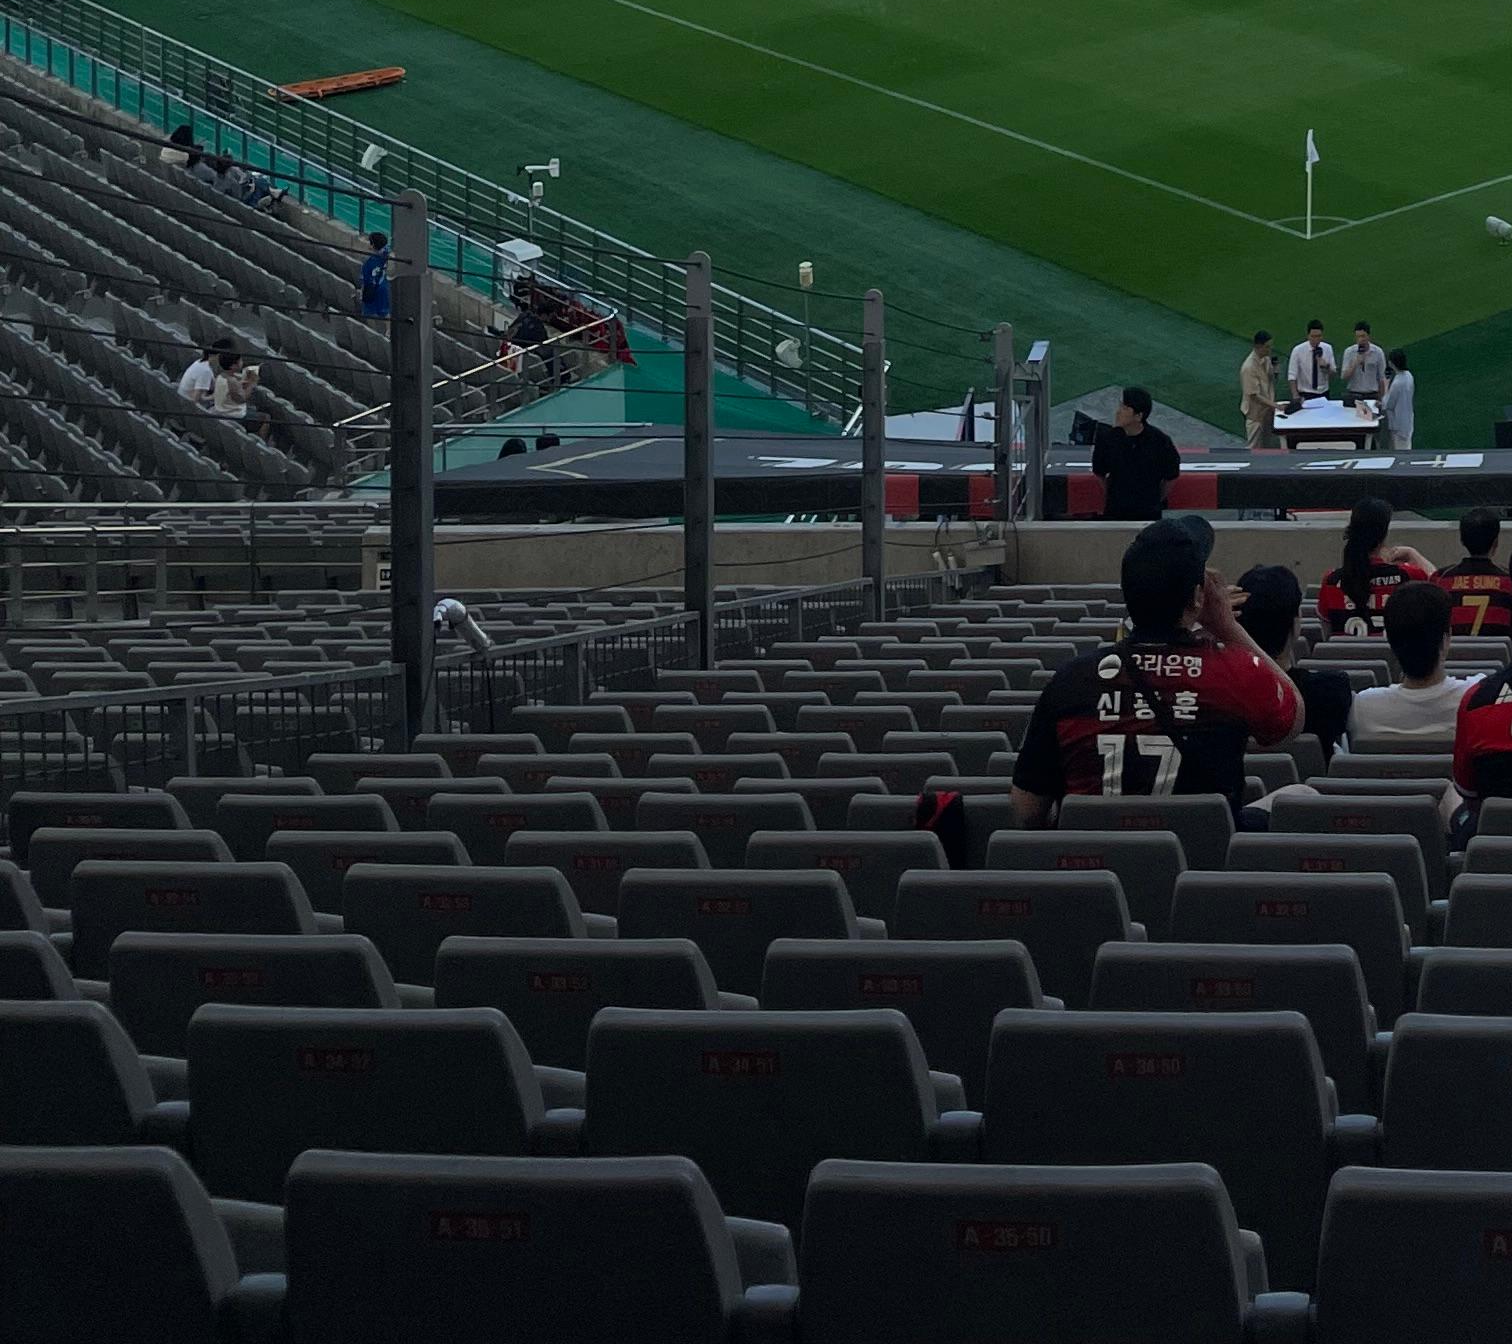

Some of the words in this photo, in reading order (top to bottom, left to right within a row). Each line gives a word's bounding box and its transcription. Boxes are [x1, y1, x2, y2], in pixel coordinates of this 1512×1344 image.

[1452, 575, 1470, 589] JAE
[1473, 575, 1501, 590] SUNG
[1462, 595, 1491, 636] 7
[1096, 733, 1183, 796] 17
